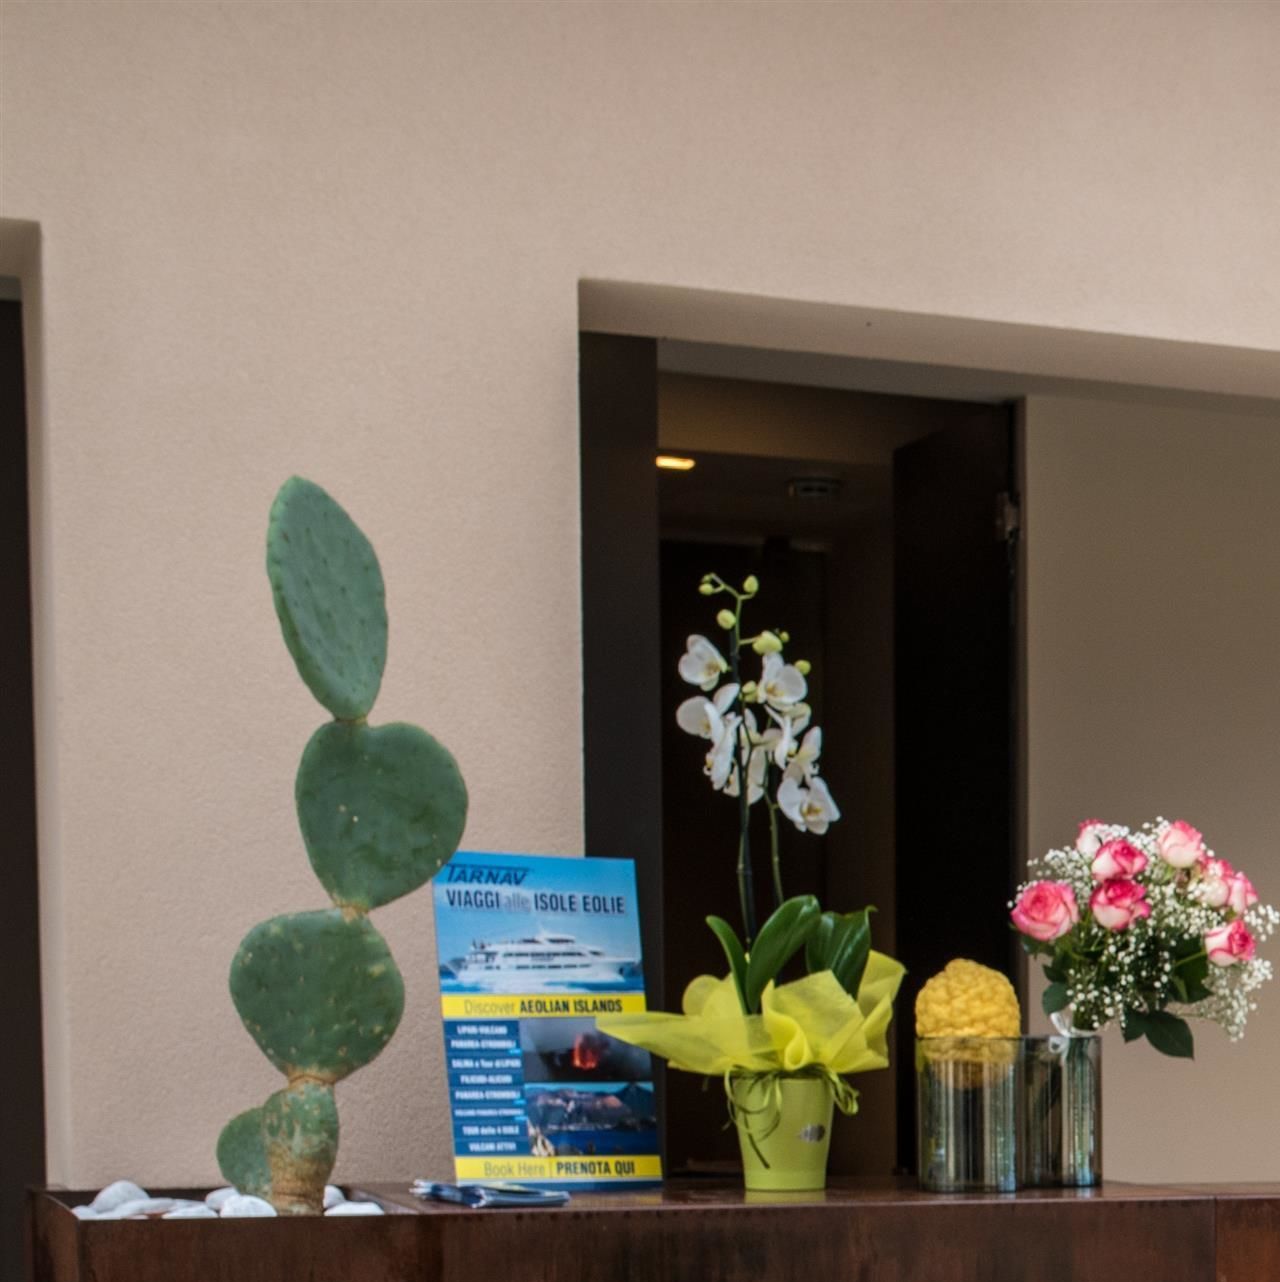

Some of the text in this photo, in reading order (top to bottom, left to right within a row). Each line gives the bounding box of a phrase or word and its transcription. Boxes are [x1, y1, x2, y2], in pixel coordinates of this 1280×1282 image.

[446, 863, 530, 886] TARNAV
[446, 890, 626, 914] VIAGGI alle ISOLE EOLIE
[463, 999, 623, 1014] Discover AEOLIAN ISLANDS
[484, 1160, 636, 1176] Book Here PRENOTA QUI
